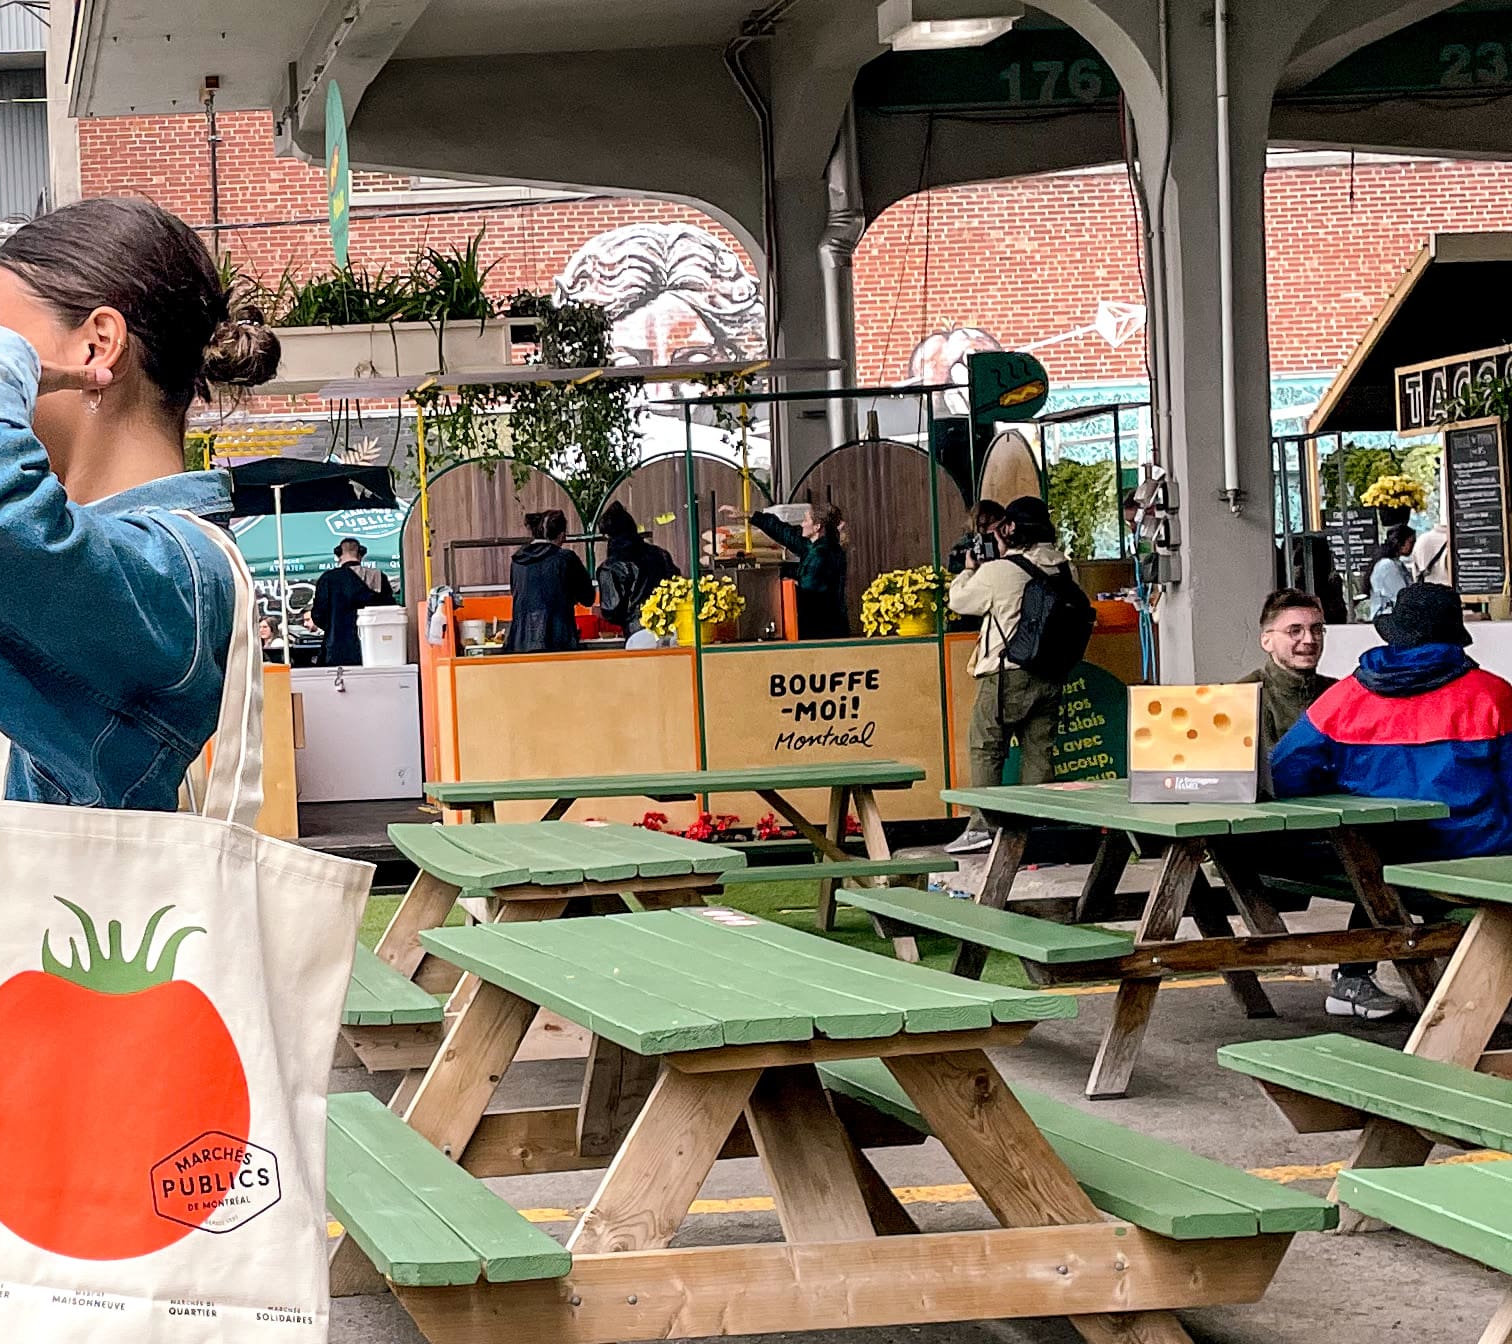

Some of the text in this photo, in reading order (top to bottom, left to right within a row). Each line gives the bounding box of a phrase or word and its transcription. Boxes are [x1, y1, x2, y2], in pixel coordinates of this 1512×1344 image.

[999, 57, 1103, 104] 176
[334, 511, 405, 531] PUBLICS
[269, 563, 305, 572] ATATER
[770, 669, 880, 697] BOUFFE
[774, 721, 876, 751] Montréal
[1063, 734, 1104, 753] avec
[174, 1146, 253, 1174] MARCHÉS
[162, 1167, 270, 1199] PUBLICS
[188, 1196, 251, 1212] DE MONTRÉAL
[51, 1295, 126, 1312] MAISONNEUVE
[168, 1306, 217, 1318] QUARTIER
[255, 1312, 313, 1325] SOLIDAIRES
